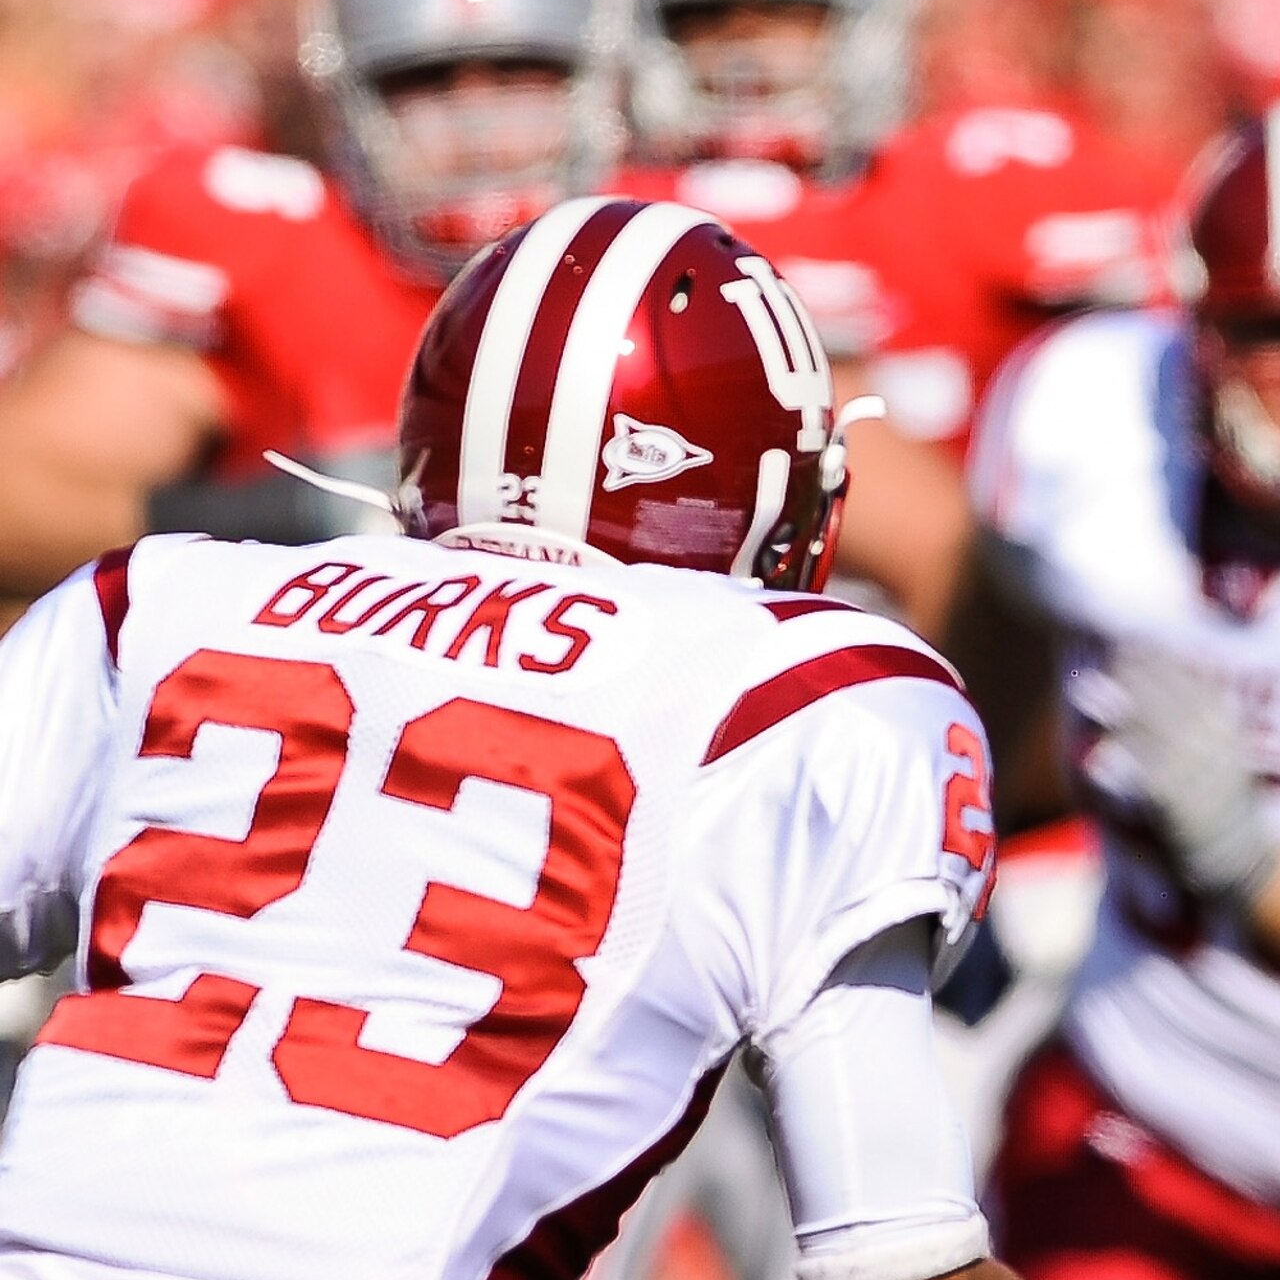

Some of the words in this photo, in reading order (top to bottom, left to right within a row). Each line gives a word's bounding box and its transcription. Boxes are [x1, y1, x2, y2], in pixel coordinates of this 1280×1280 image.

[498, 473, 546, 524] 23
[251, 561, 618, 676] BURKS
[33, 647, 638, 1139] 23
[942, 723, 997, 920] 2
